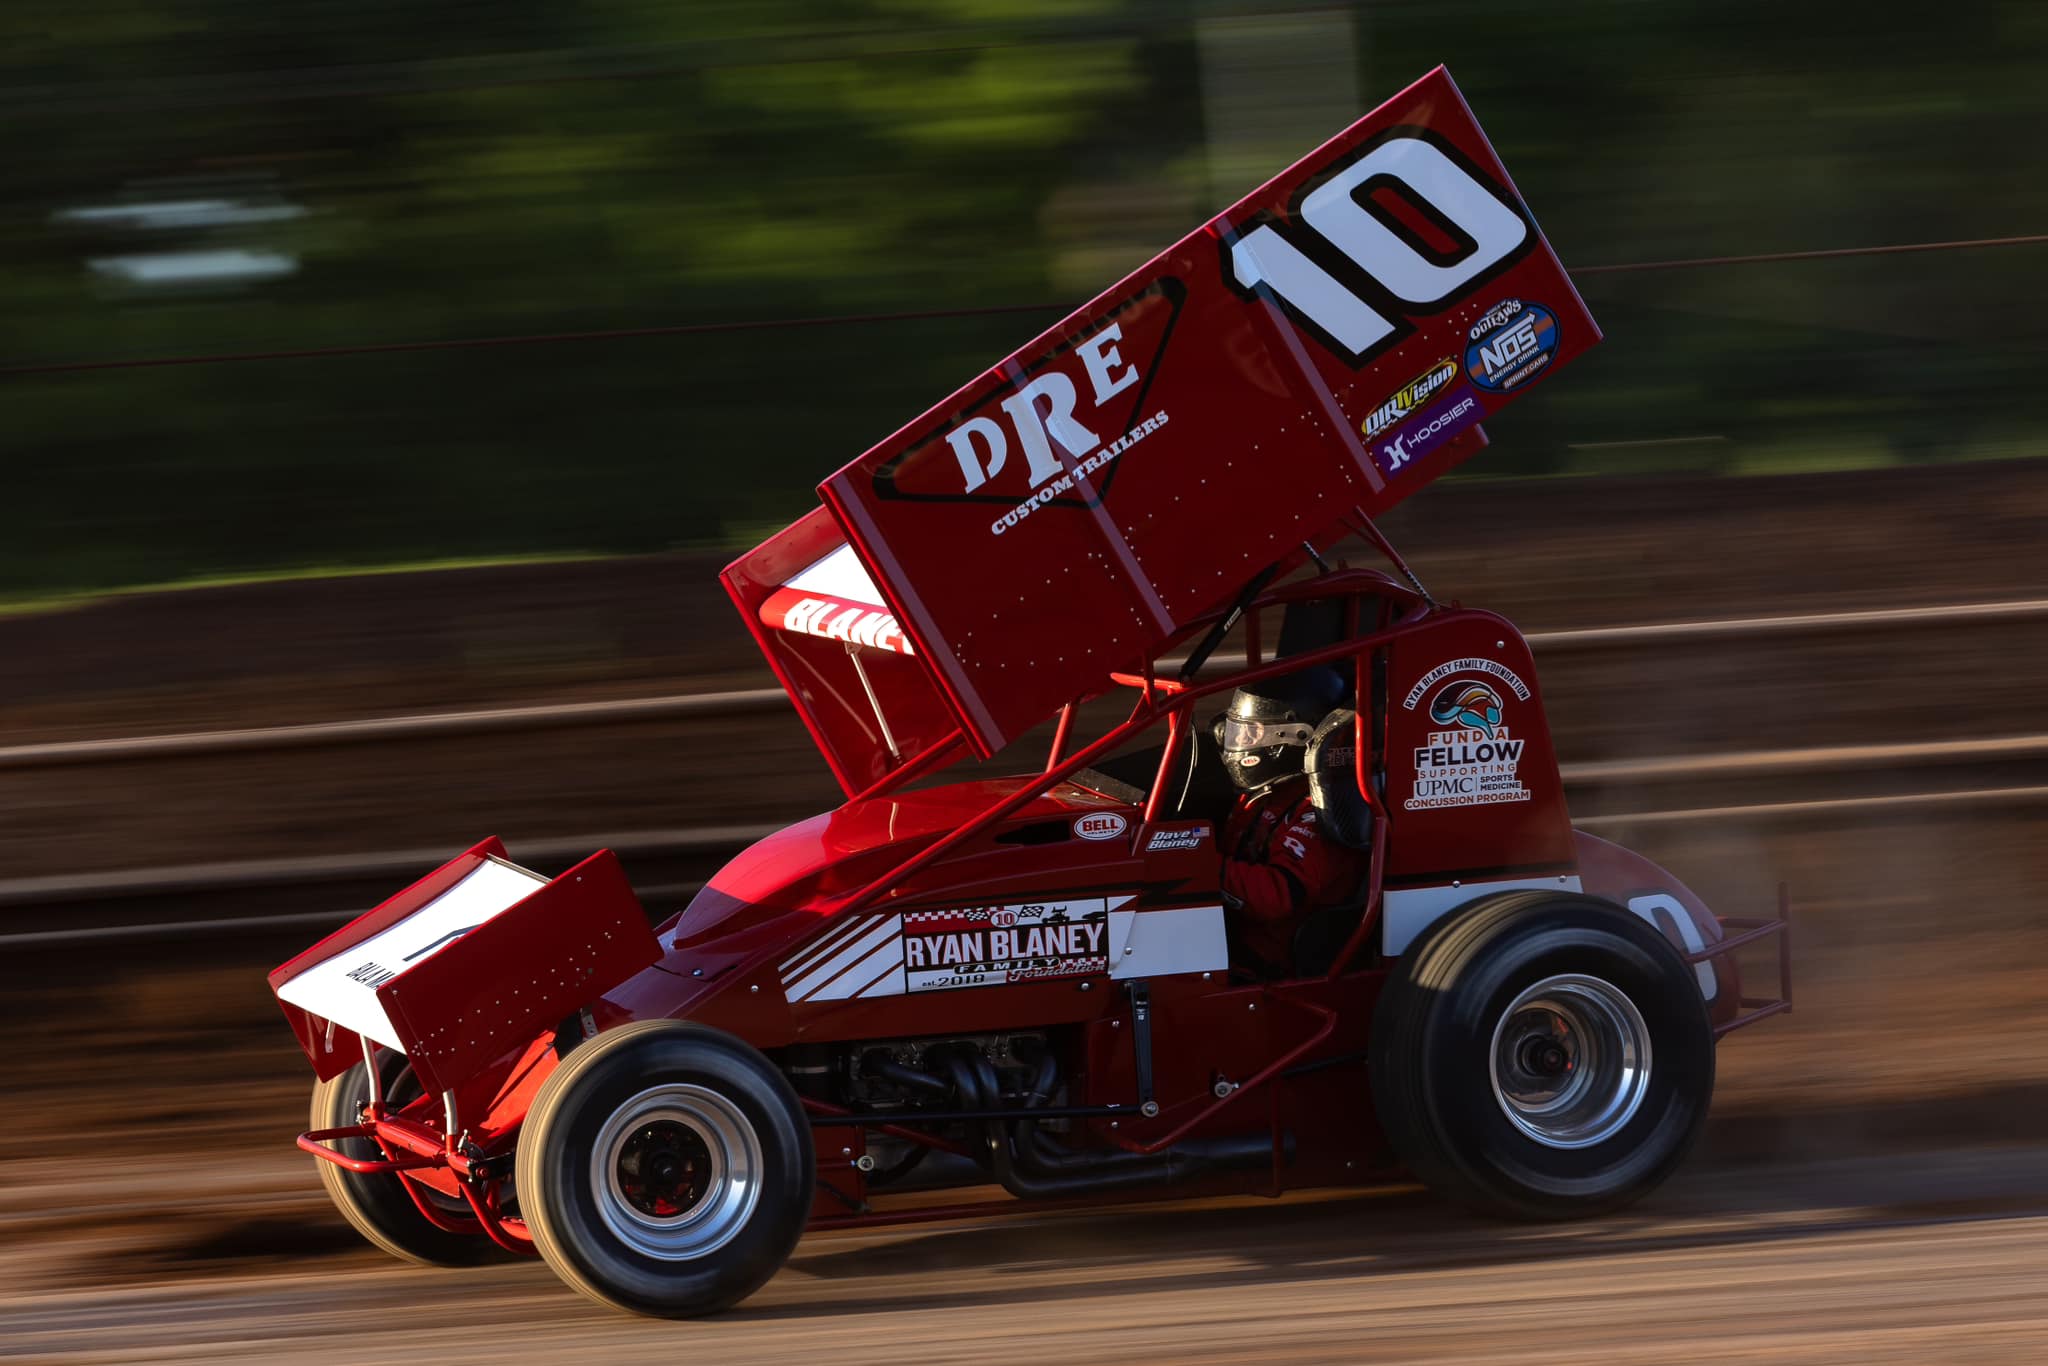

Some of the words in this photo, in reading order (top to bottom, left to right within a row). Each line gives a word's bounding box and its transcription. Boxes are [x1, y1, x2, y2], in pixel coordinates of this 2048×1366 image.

[1232, 138, 1527, 355] 10
[1480, 313, 1537, 375] NOS
[1489, 359, 1517, 383] ENERGY
[1518, 345, 1540, 364] DRINK
[1529, 353, 1549, 370] CARS
[945, 322, 1140, 494] DRE
[1407, 398, 1475, 448] HOOSIER
[991, 475, 1074, 536] CUSTOM
[1072, 410, 1170, 480] TRAILERS
[784, 598, 915, 656] BLANE
[1405, 686, 1424, 709] RYAN
[1423, 664, 1452, 687] BLANEY
[1454, 659, 1486, 671] FAMILY
[1485, 661, 1530, 699] FOUNDATION
[1429, 730, 1484, 746] FUND
[1495, 729, 1507, 740] A
[1416, 741, 1520, 769] FELLOW
[1419, 763, 1515, 779] SUPPORTING
[1416, 777, 1473, 797] UPMC
[1480, 774, 1513, 783] SPORTS
[1480, 782, 1521, 791] MEDICINE
[1405, 795, 1474, 809] CONCUSSION
[1476, 790, 1530, 803] PROGRAM
[1082, 818, 1119, 832] BELL
[1148, 838, 1200, 850] Blaney
[1153, 831, 1192, 840] Dave
[996, 913, 1015, 925] 10
[906, 933, 983, 967] RYAN
[990, 922, 1105, 960] BLANEY
[958, 958, 1059, 974] FAMILY
[1008, 962, 1106, 982] Foundation
[937, 973, 985, 987] 2018
